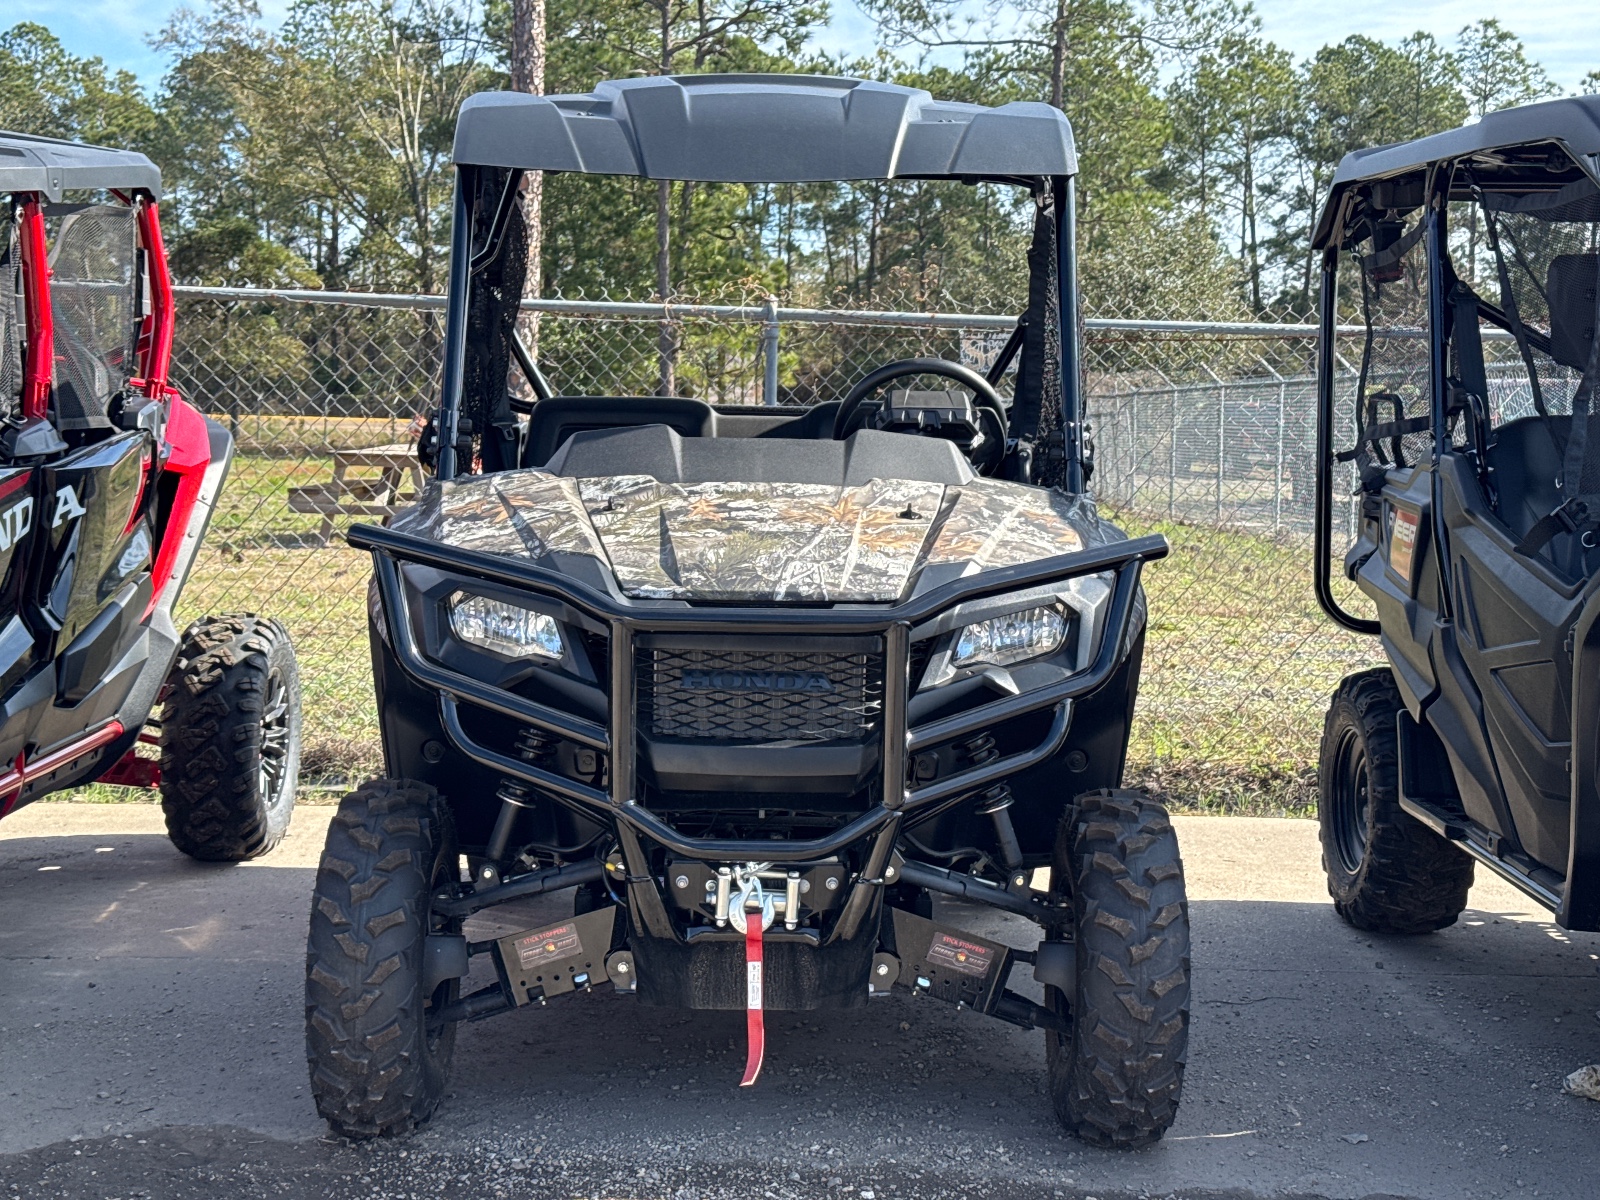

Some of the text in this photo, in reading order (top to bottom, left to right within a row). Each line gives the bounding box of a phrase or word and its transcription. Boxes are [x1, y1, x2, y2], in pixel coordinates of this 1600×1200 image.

[680, 669, 836, 692] HONDA
[523, 928, 567, 945] STICK STOPPERS
[943, 936, 958, 945] STICK
[959, 941, 985, 953] STOPPERS
